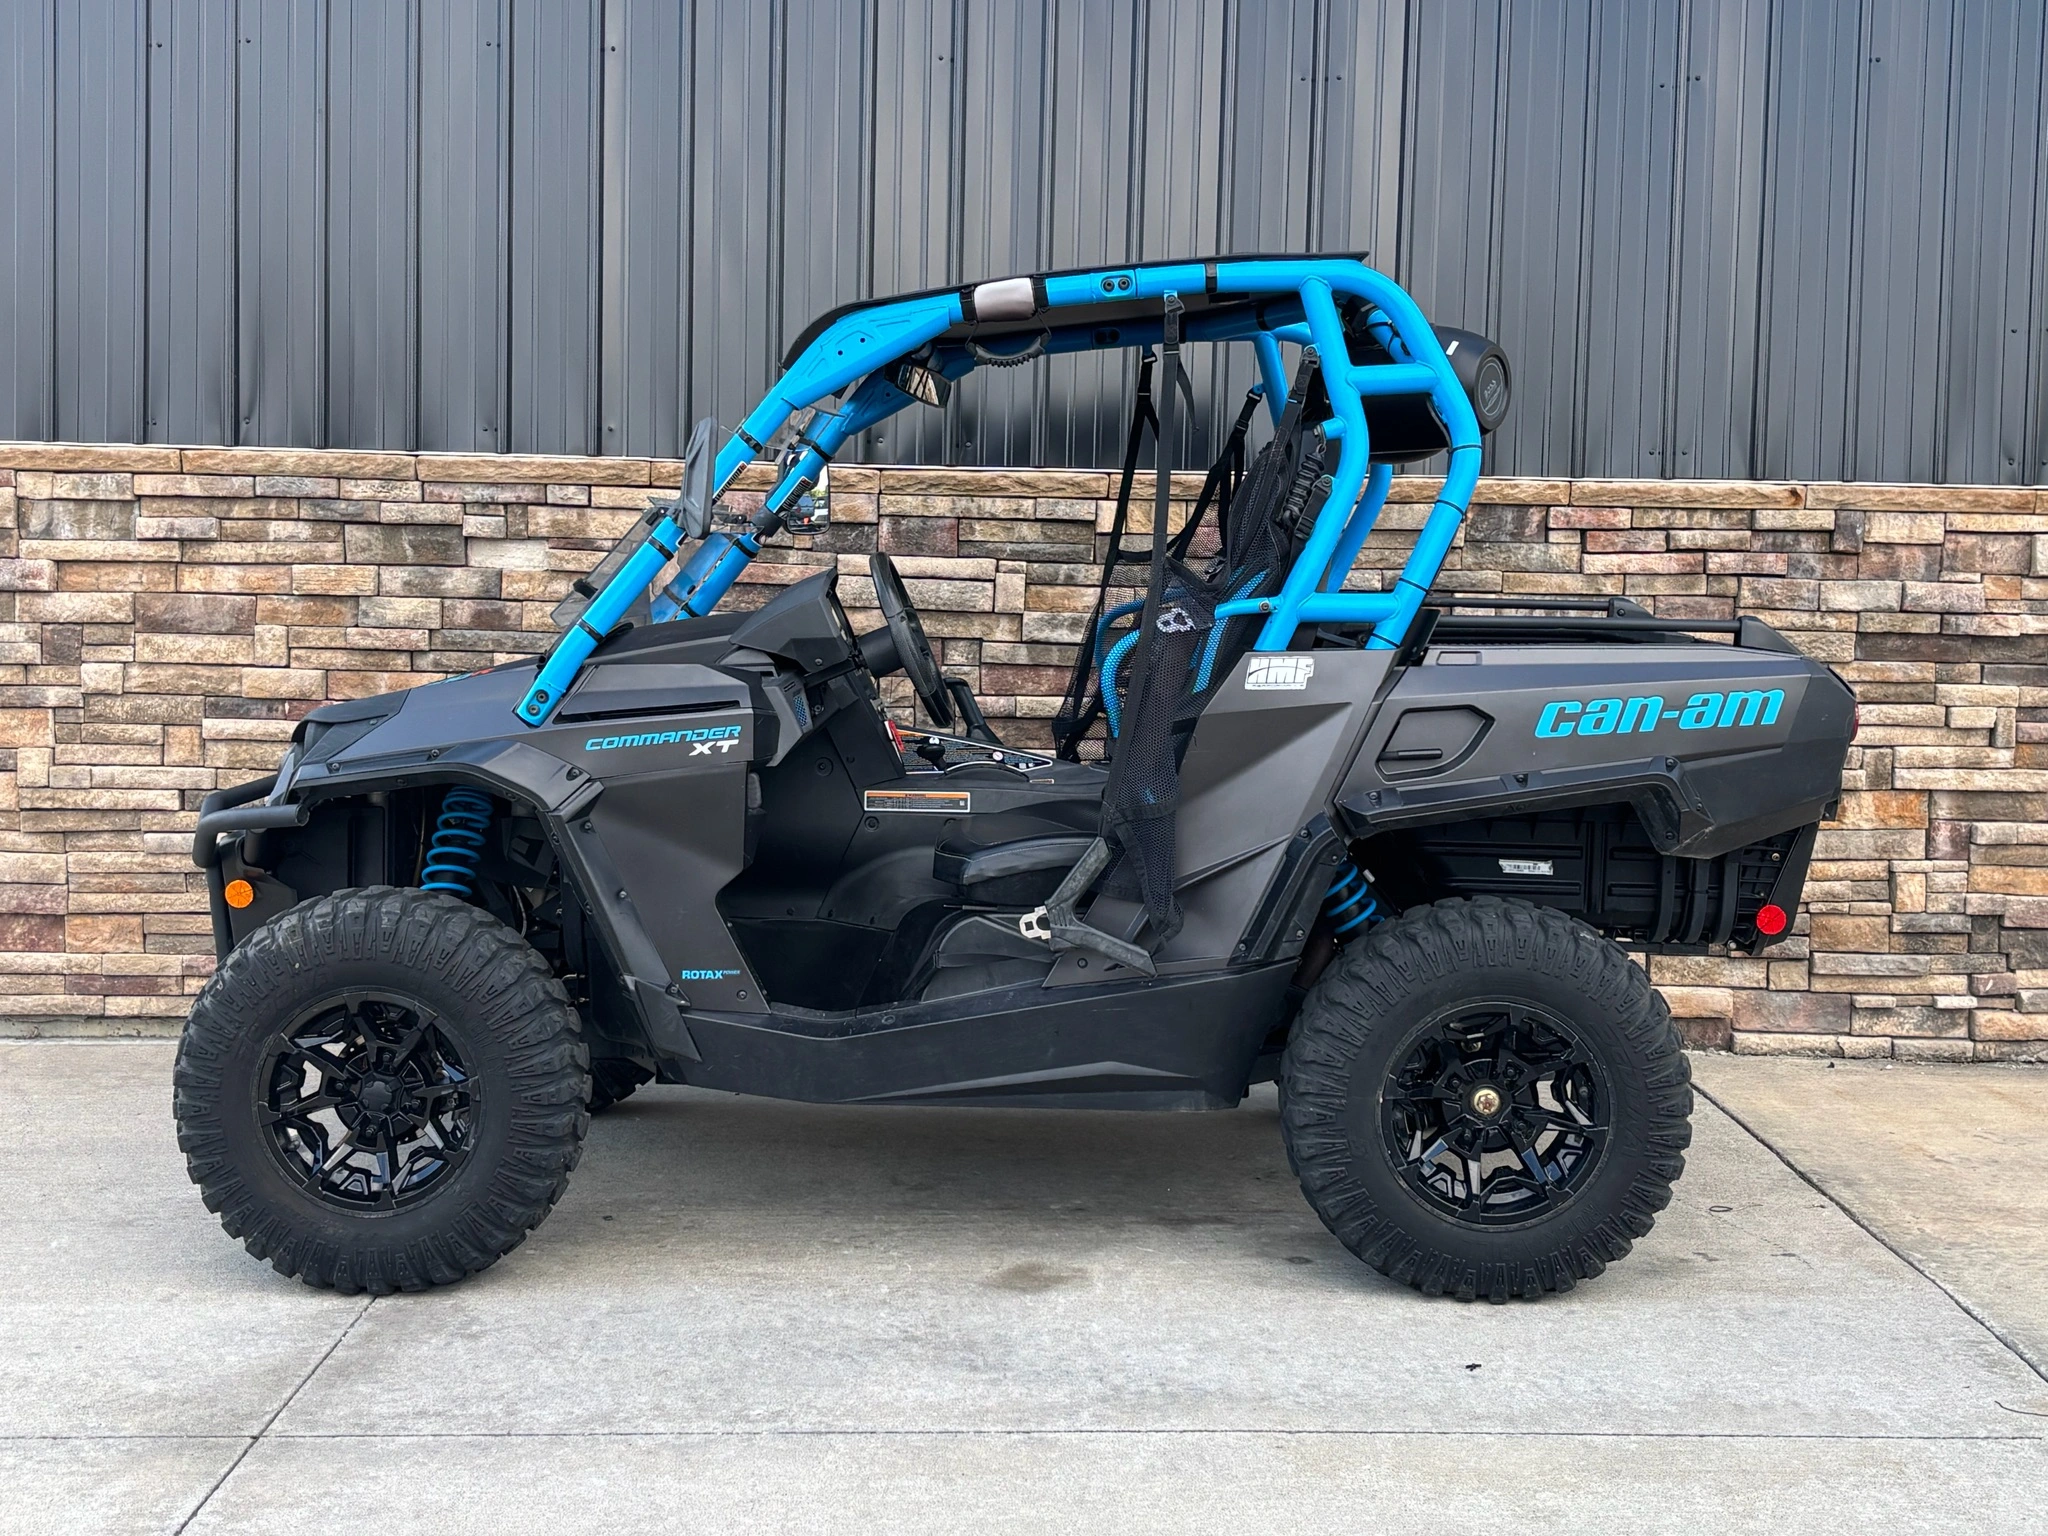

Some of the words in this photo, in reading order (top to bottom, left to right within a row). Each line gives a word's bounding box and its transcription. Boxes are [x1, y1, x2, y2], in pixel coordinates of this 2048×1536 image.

[585, 725, 742, 751] COMMANDER
[688, 739, 740, 756] XT
[681, 969, 723, 980] ROTAX
